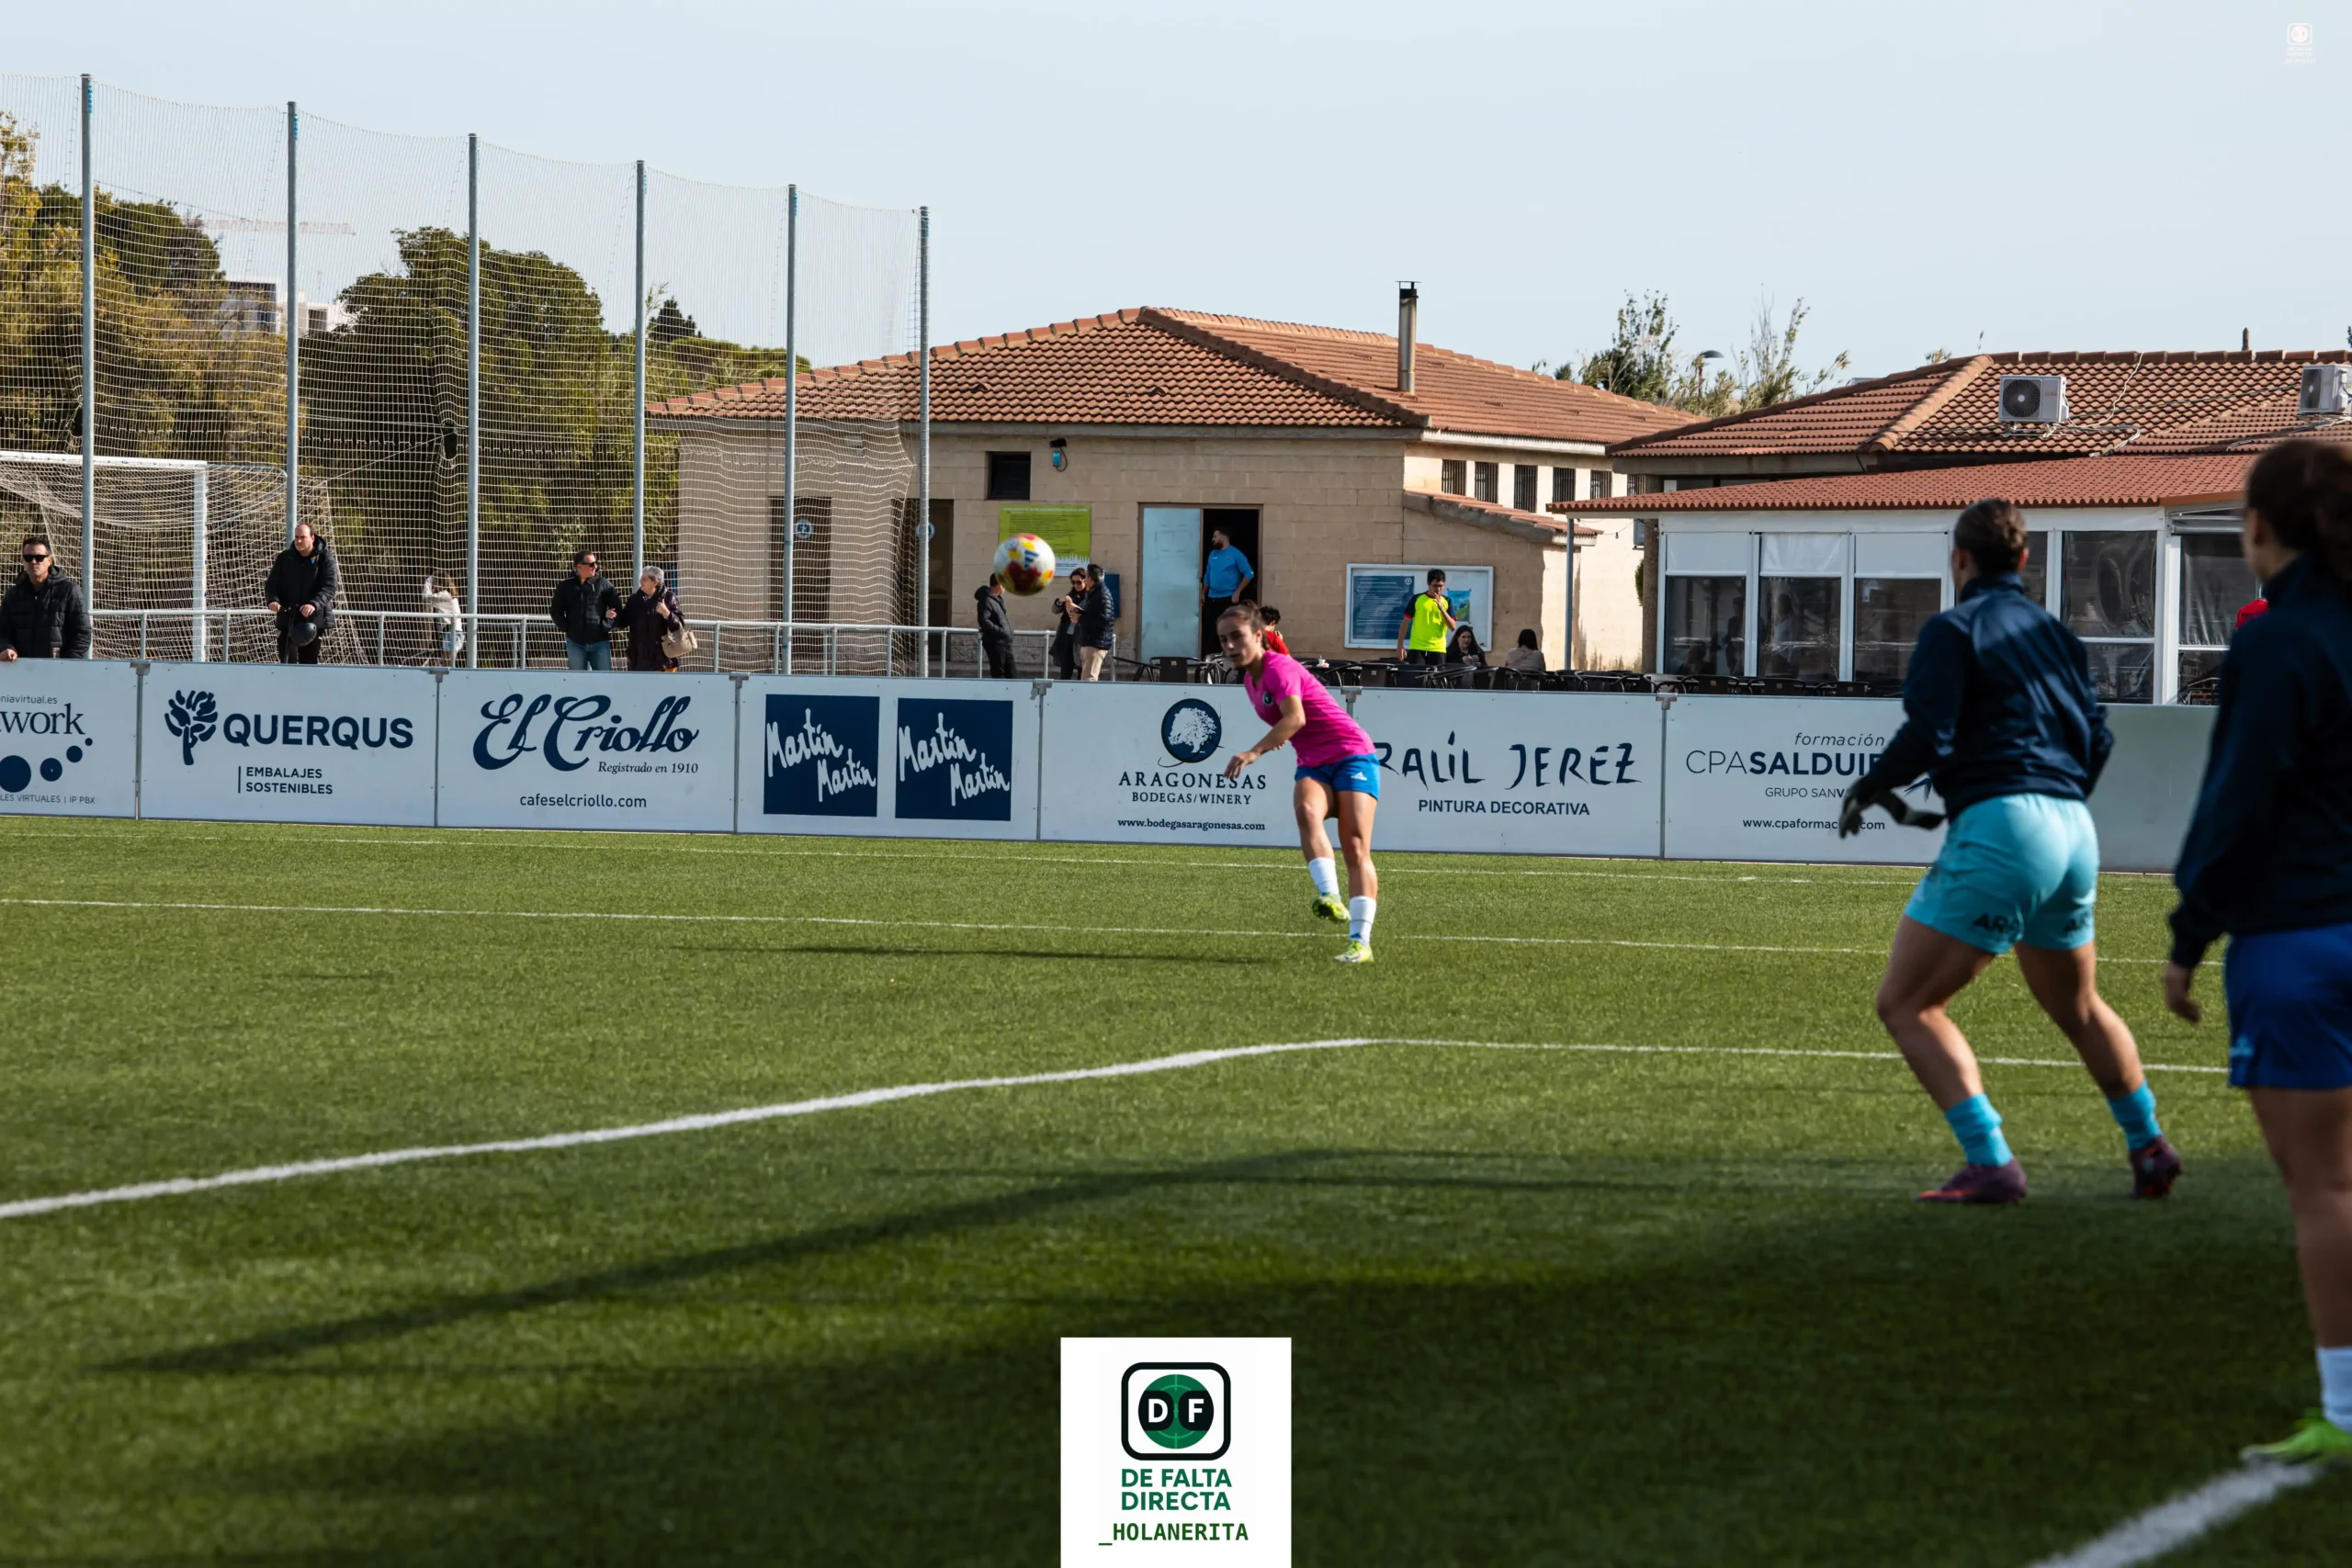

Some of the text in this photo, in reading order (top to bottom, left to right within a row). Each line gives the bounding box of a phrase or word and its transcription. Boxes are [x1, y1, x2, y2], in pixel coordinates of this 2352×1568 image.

[0, 703, 86, 736] work
[223, 713, 413, 750] QUERQUS
[473, 694, 699, 772] El Criollo
[1794, 732, 1885, 747] formación
[245, 766, 323, 780] EMBALAJES
[598, 761, 699, 775] Registrado en 1910
[1118, 771, 1267, 790] ARAGONESAS
[245, 782, 334, 795] SOSTENIBLES
[1765, 787, 1846, 799] GRUPO SANV
[17, 794, 61, 804] VIRTUALES
[69, 795, 77, 804] IP
[79, 796, 96, 805] PBX
[519, 793, 648, 808] cafeselcriollo.com
[1418, 799, 1590, 816] PINTURA DECORATIVA
[1117, 818, 1266, 831] www.bodegasaragonesas.com
[1742, 818, 1885, 830] www.cpaformaccom
